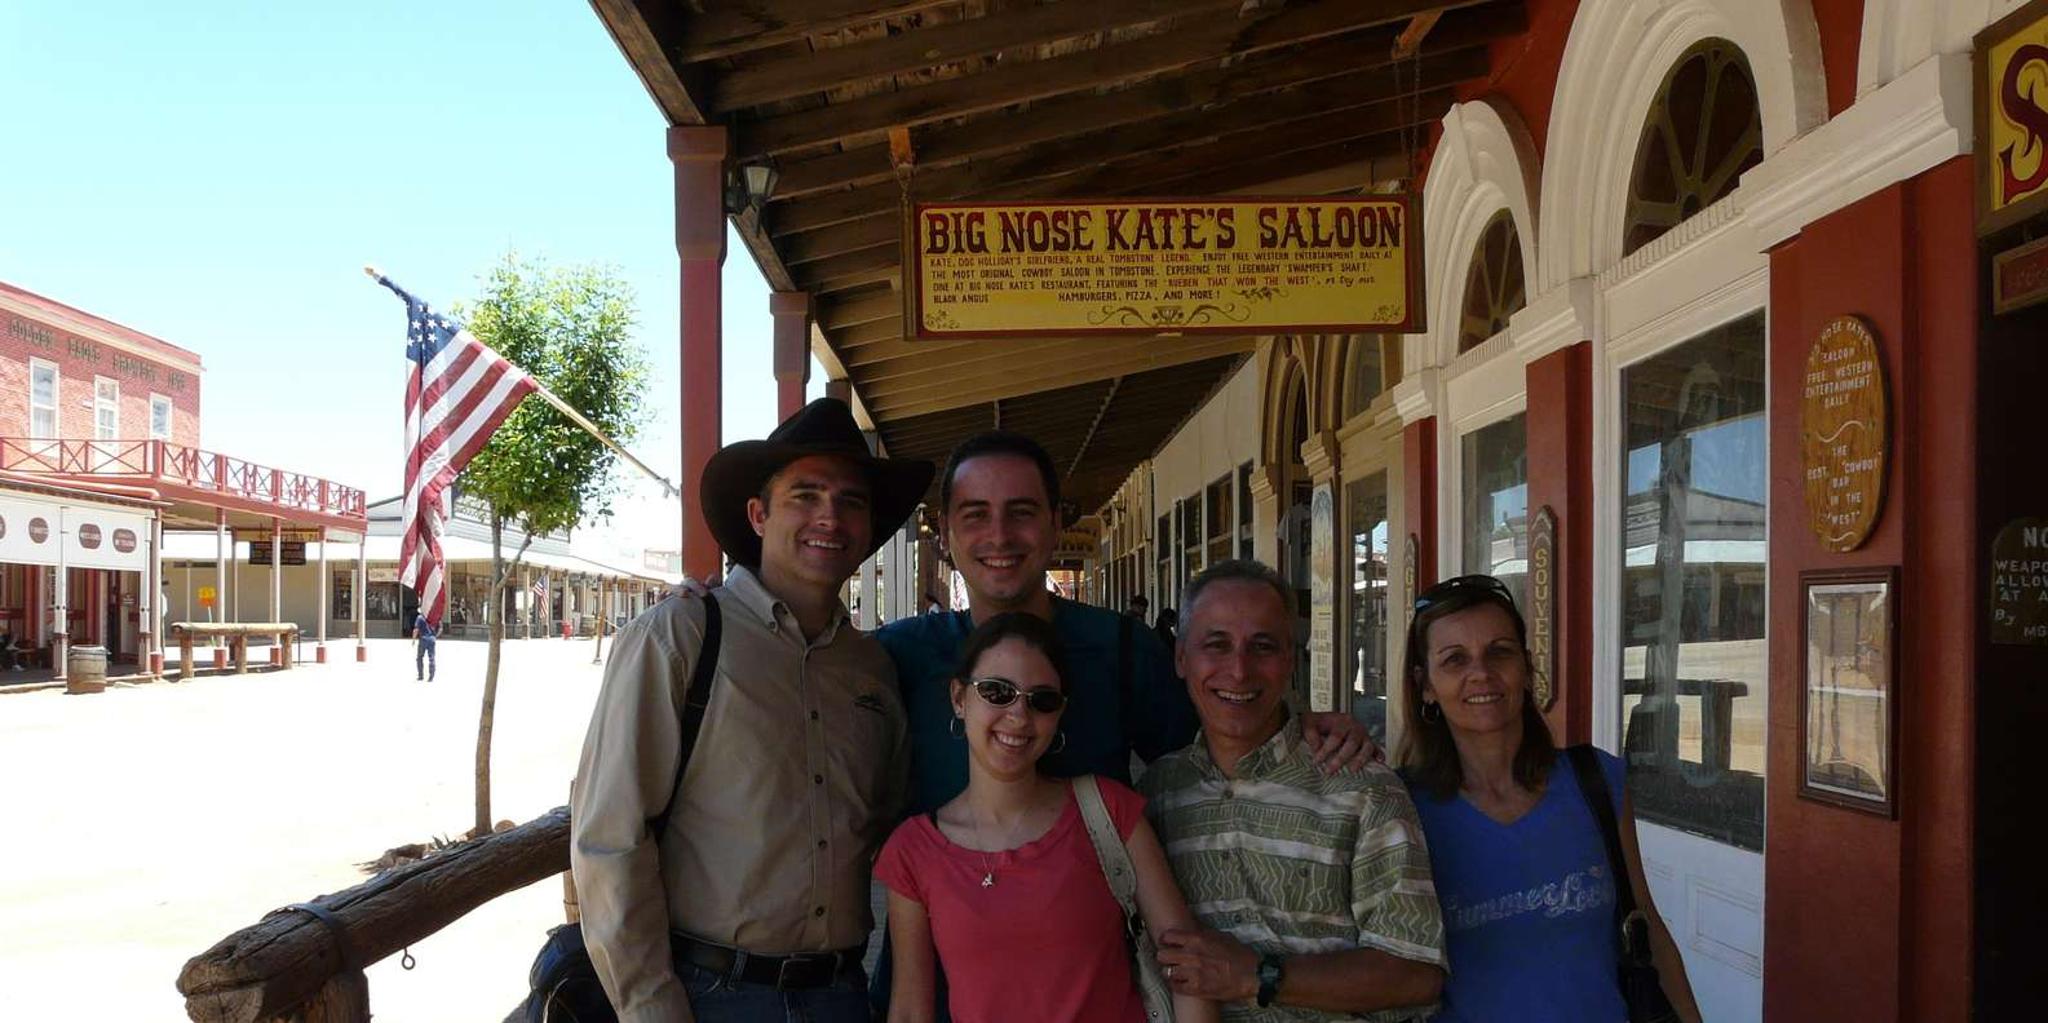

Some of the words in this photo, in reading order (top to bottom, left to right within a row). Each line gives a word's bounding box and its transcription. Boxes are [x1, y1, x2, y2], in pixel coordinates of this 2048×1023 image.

[926, 210, 989, 253] BIG
[998, 210, 1095, 252] NOSE
[1105, 207, 1236, 250] KATE'S
[1258, 206, 1401, 250] SALOON
[1086, 255, 1105, 264] REAL
[1110, 254, 1154, 263] TOMBSTONE
[1203, 252, 1226, 261] ENJOY
[1232, 252, 1249, 261] FREE
[1254, 252, 1288, 260] WESTERN
[1295, 251, 1353, 260] ENTERTAINMENT
[1360, 251, 1380, 259] DAILY
[932, 270, 946, 279] THE
[953, 269, 975, 279] MOST
[980, 268, 1015, 278] ORIGINAL
[1021, 267, 1053, 277] COWBOY
[1061, 267, 1090, 276] SALOON
[1096, 267, 1105, 276] IN
[1166, 264, 1210, 275] EXPERIENCE
[1216, 264, 1231, 273] THE
[1238, 263, 1280, 273] LEGENDARY
[954, 281, 965, 291] AT
[969, 281, 982, 290] BIG
[985, 281, 1004, 290] NOSE
[1096, 279, 1138, 288] FEATURING
[1144, 279, 1158, 288] THE
[1207, 277, 1228, 286] THAT
[1236, 277, 1257, 286] WON
[1264, 276, 1279, 285] THE
[933, 294, 956, 304] BLACK
[962, 293, 989, 304] ANGUS
[1163, 290, 1183, 300] AND
[1821, 346, 1857, 363] SALOON
[1807, 370, 1826, 385] FREE
[1835, 360, 1873, 379] WESTERN
[1804, 374, 1870, 399] ENTERTAINMENT
[1824, 392, 1850, 409] DAILY
[1832, 445, 1849, 456] THE
[1832, 476, 1850, 489] BAR
[1831, 495, 1840, 506] IN
[1846, 491, 1862, 505] THE
